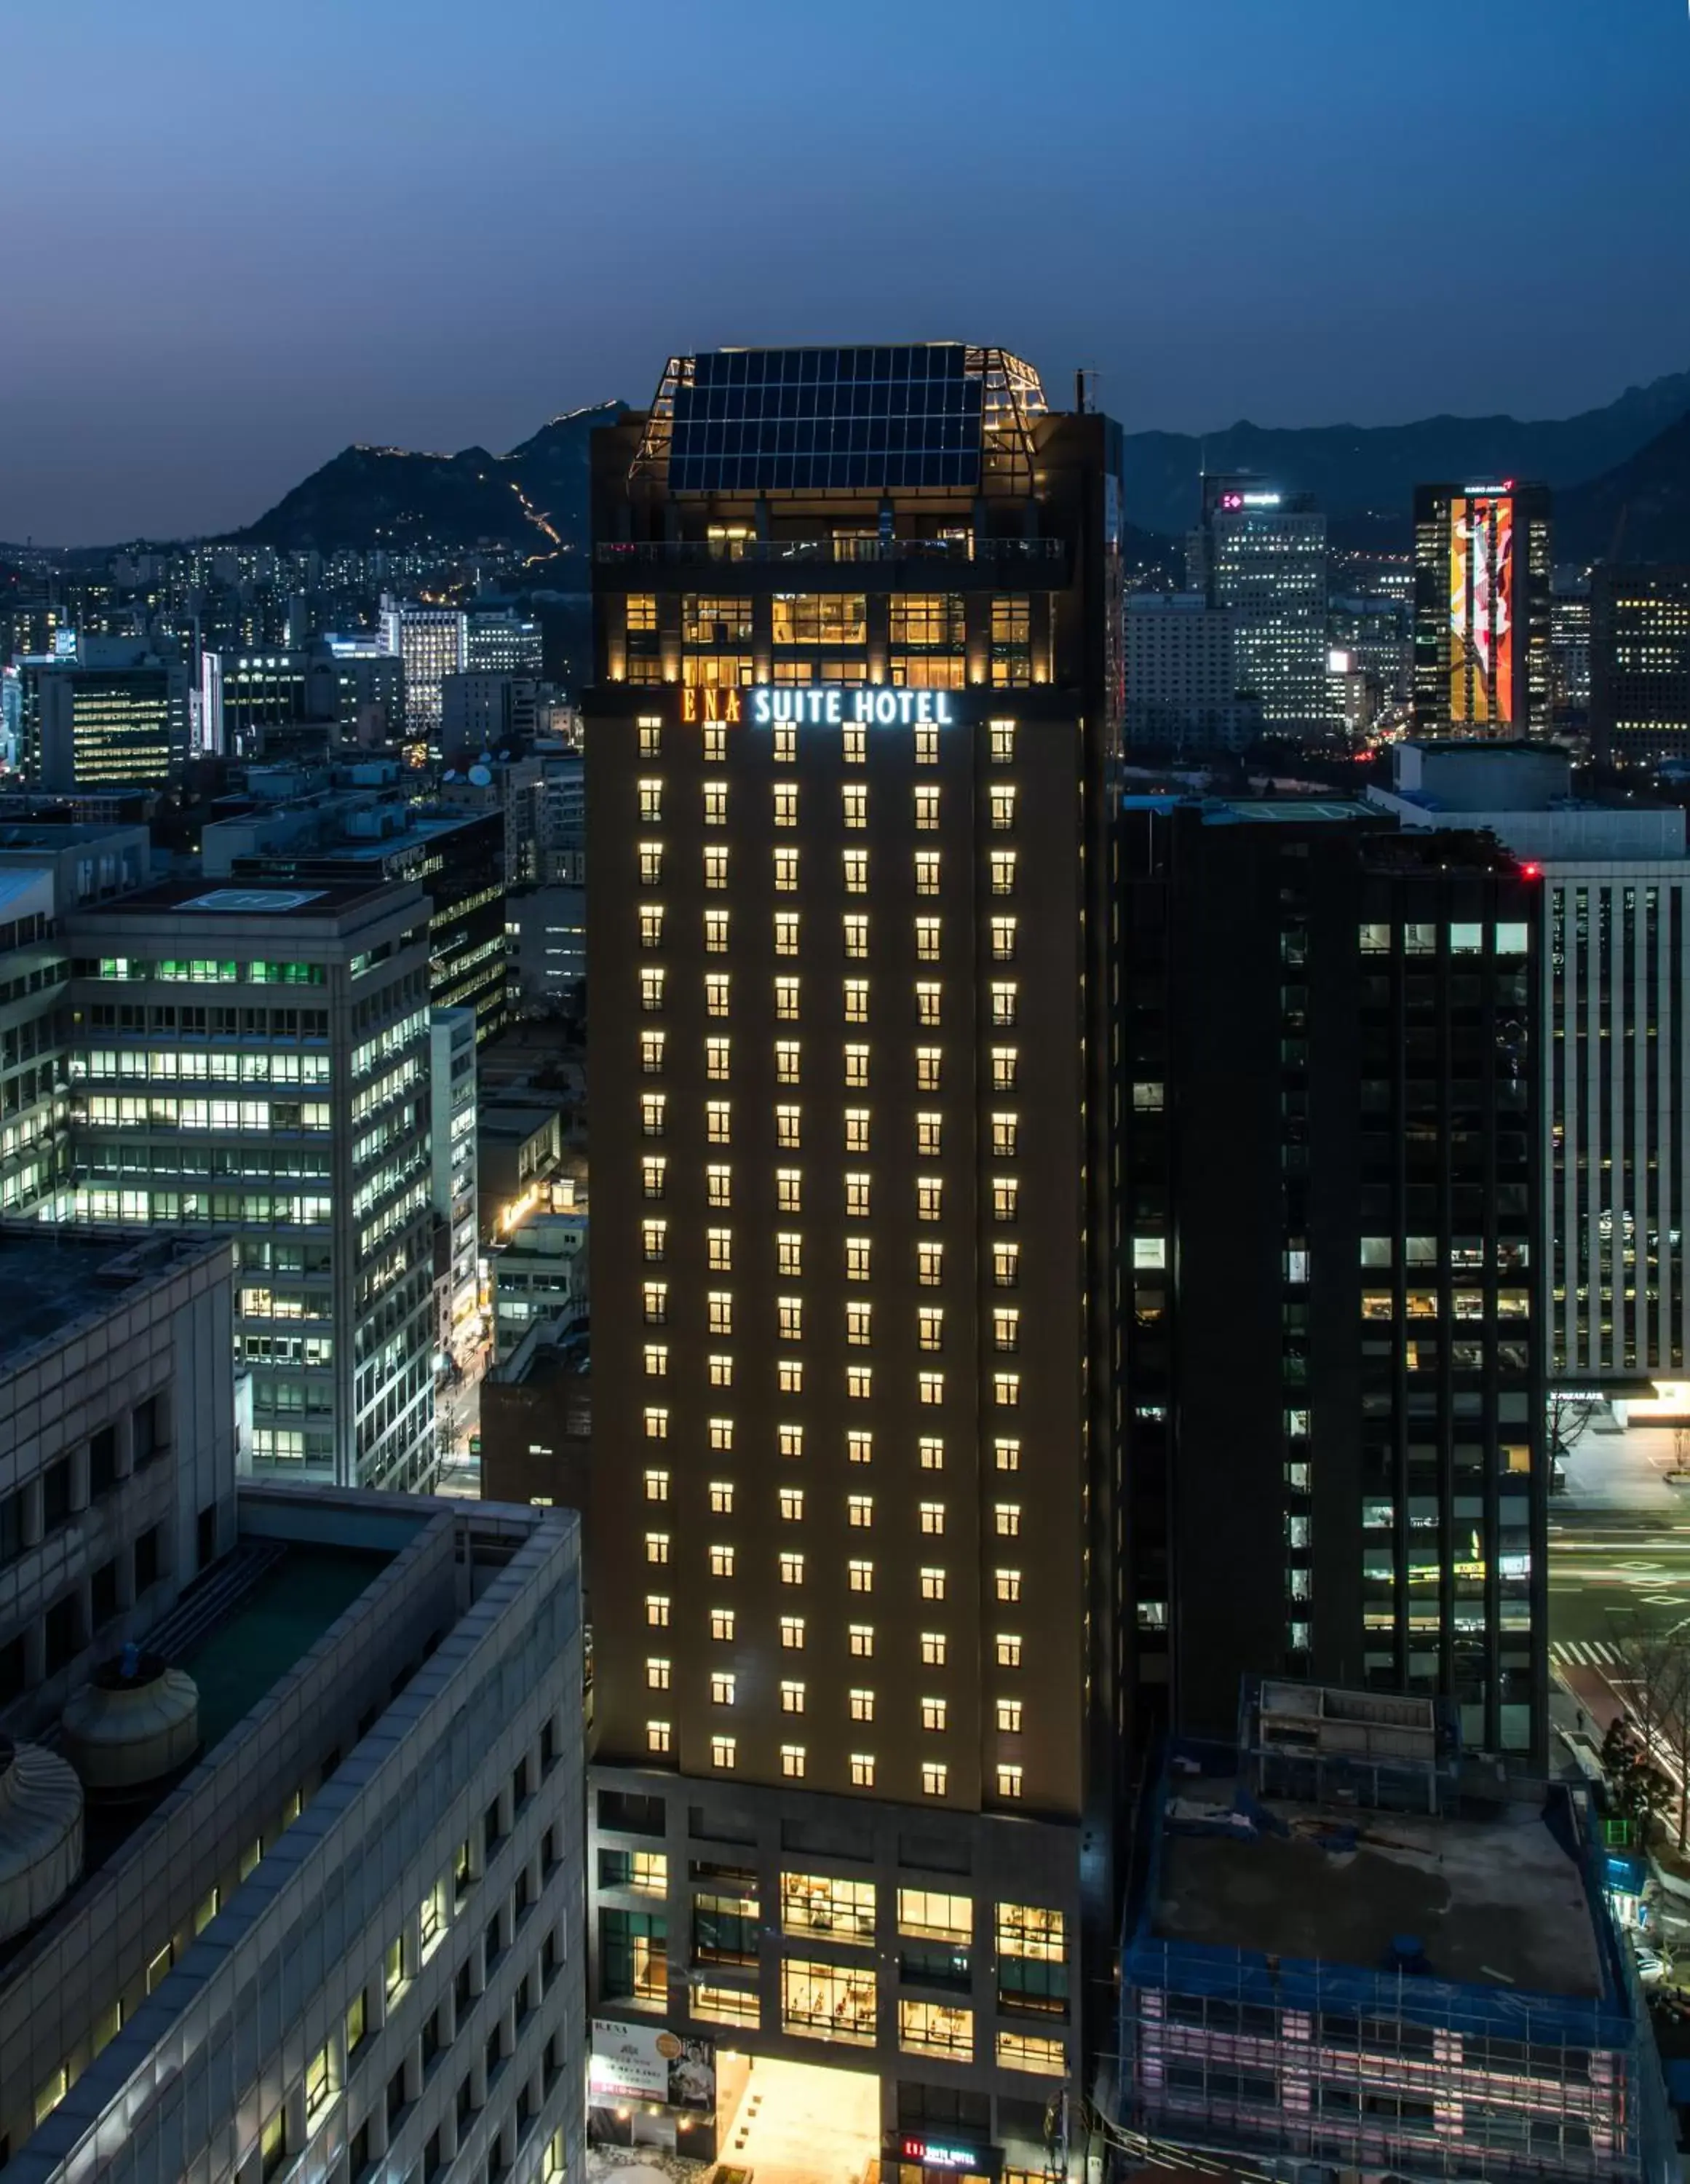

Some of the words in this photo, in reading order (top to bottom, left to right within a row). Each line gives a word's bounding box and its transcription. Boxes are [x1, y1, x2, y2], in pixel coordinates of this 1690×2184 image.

[683, 688, 740, 721] ENA
[755, 690, 841, 723] SUITE
[855, 691, 953, 724] HOTEL
